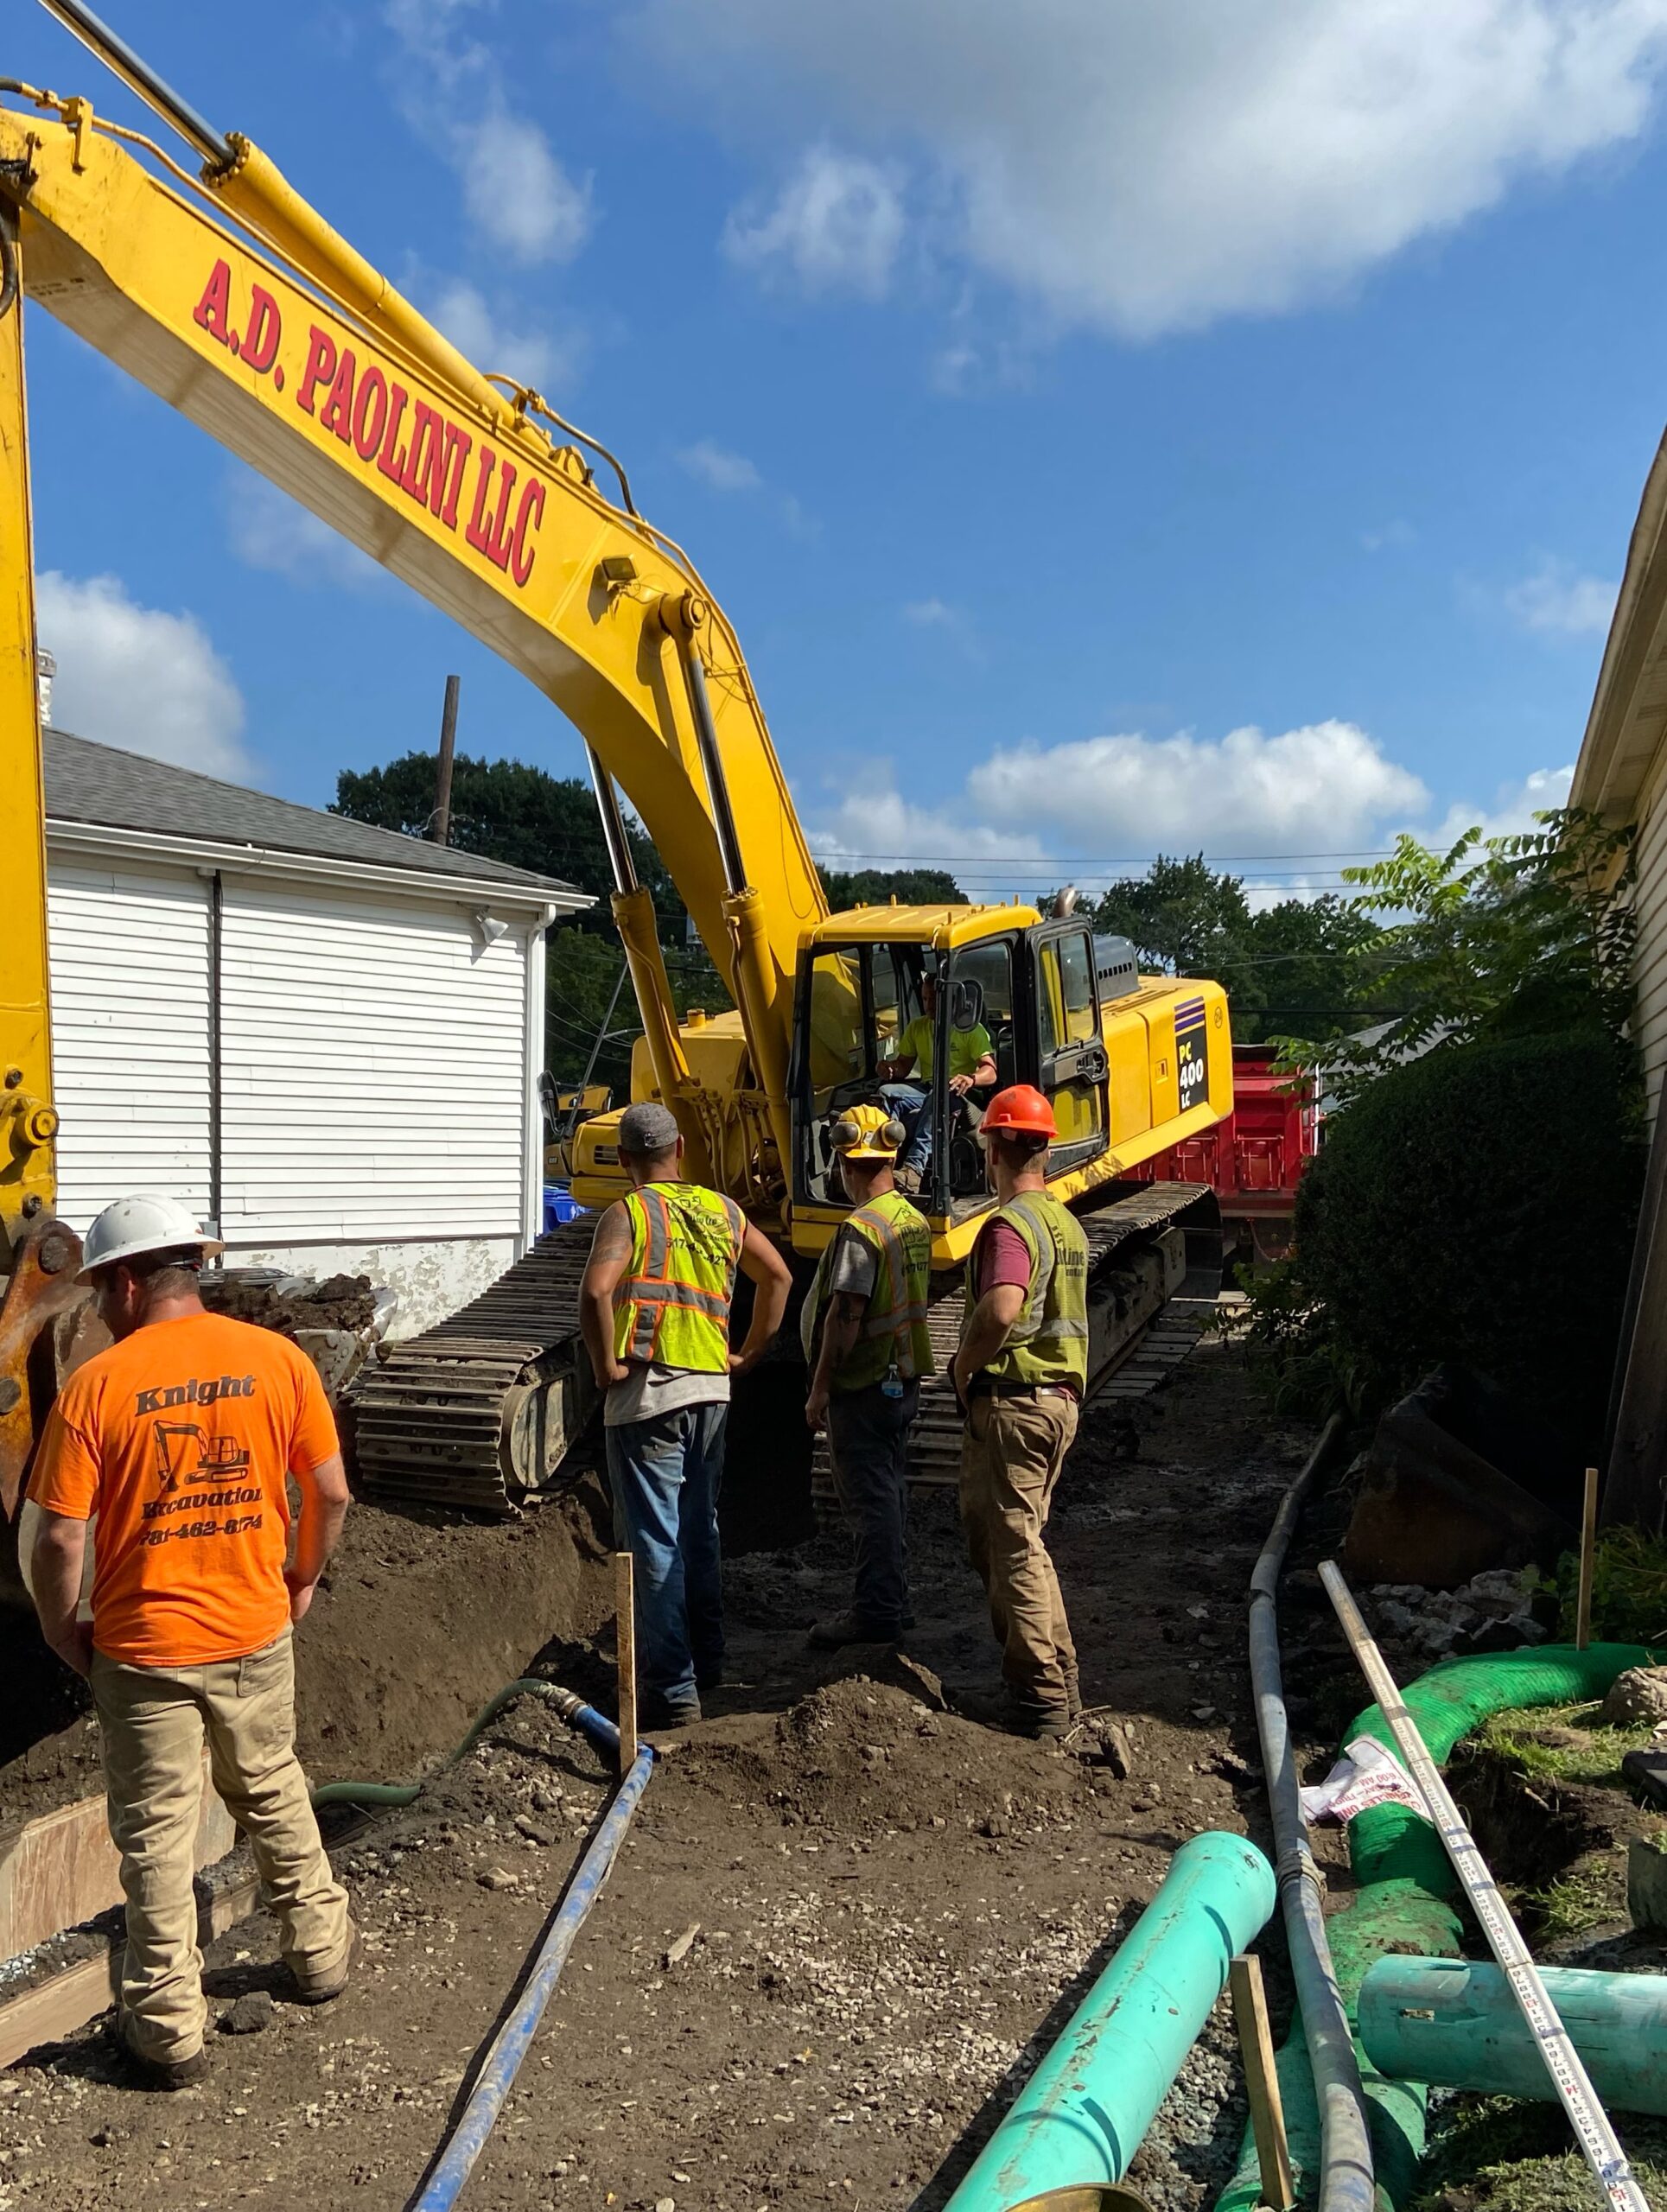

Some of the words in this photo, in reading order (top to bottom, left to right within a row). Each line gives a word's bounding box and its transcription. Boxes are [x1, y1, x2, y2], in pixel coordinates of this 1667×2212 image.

[194, 258, 283, 391] A.D.
[296, 324, 472, 532] PAOLINI
[466, 445, 545, 588] LLC
[1179, 1041, 1192, 1065] PC
[1180, 1058, 1204, 1090] 400
[1181, 1090, 1191, 1109] LC
[135, 1375, 257, 1417] Knight
[139, 1514, 263, 1546] 781-462-874
[1359, 1777, 1374, 1787] AM
[1337, 1805, 1359, 1821] ONL
